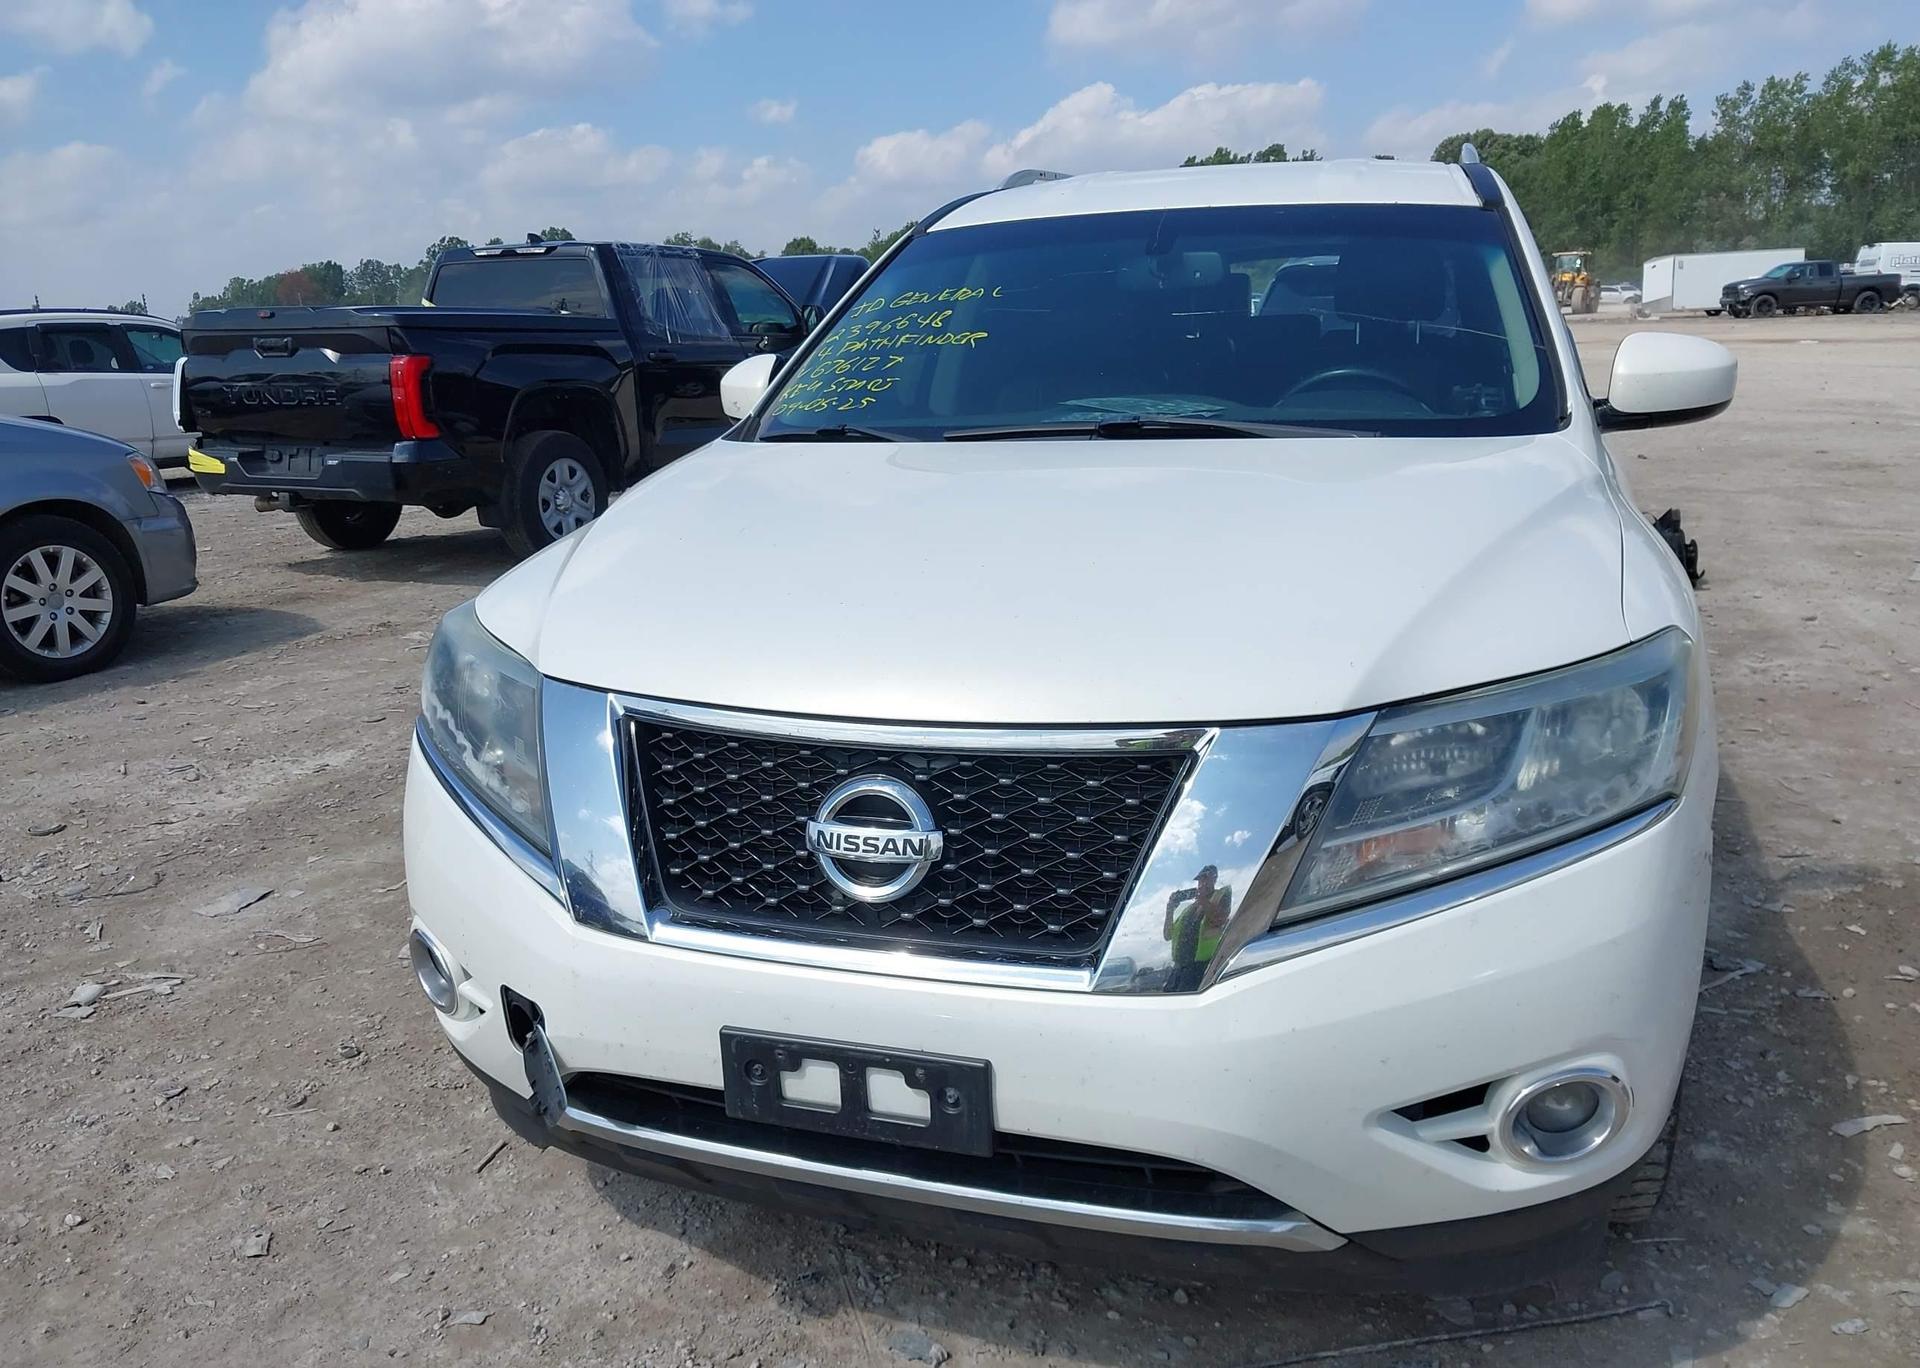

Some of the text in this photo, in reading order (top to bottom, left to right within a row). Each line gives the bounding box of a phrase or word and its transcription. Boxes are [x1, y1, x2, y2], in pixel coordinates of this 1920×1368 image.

[836, 332, 989, 356] PATHFINDER
[222, 386, 343, 406] TUNDRA
[816, 830, 924, 857] NISSAN
